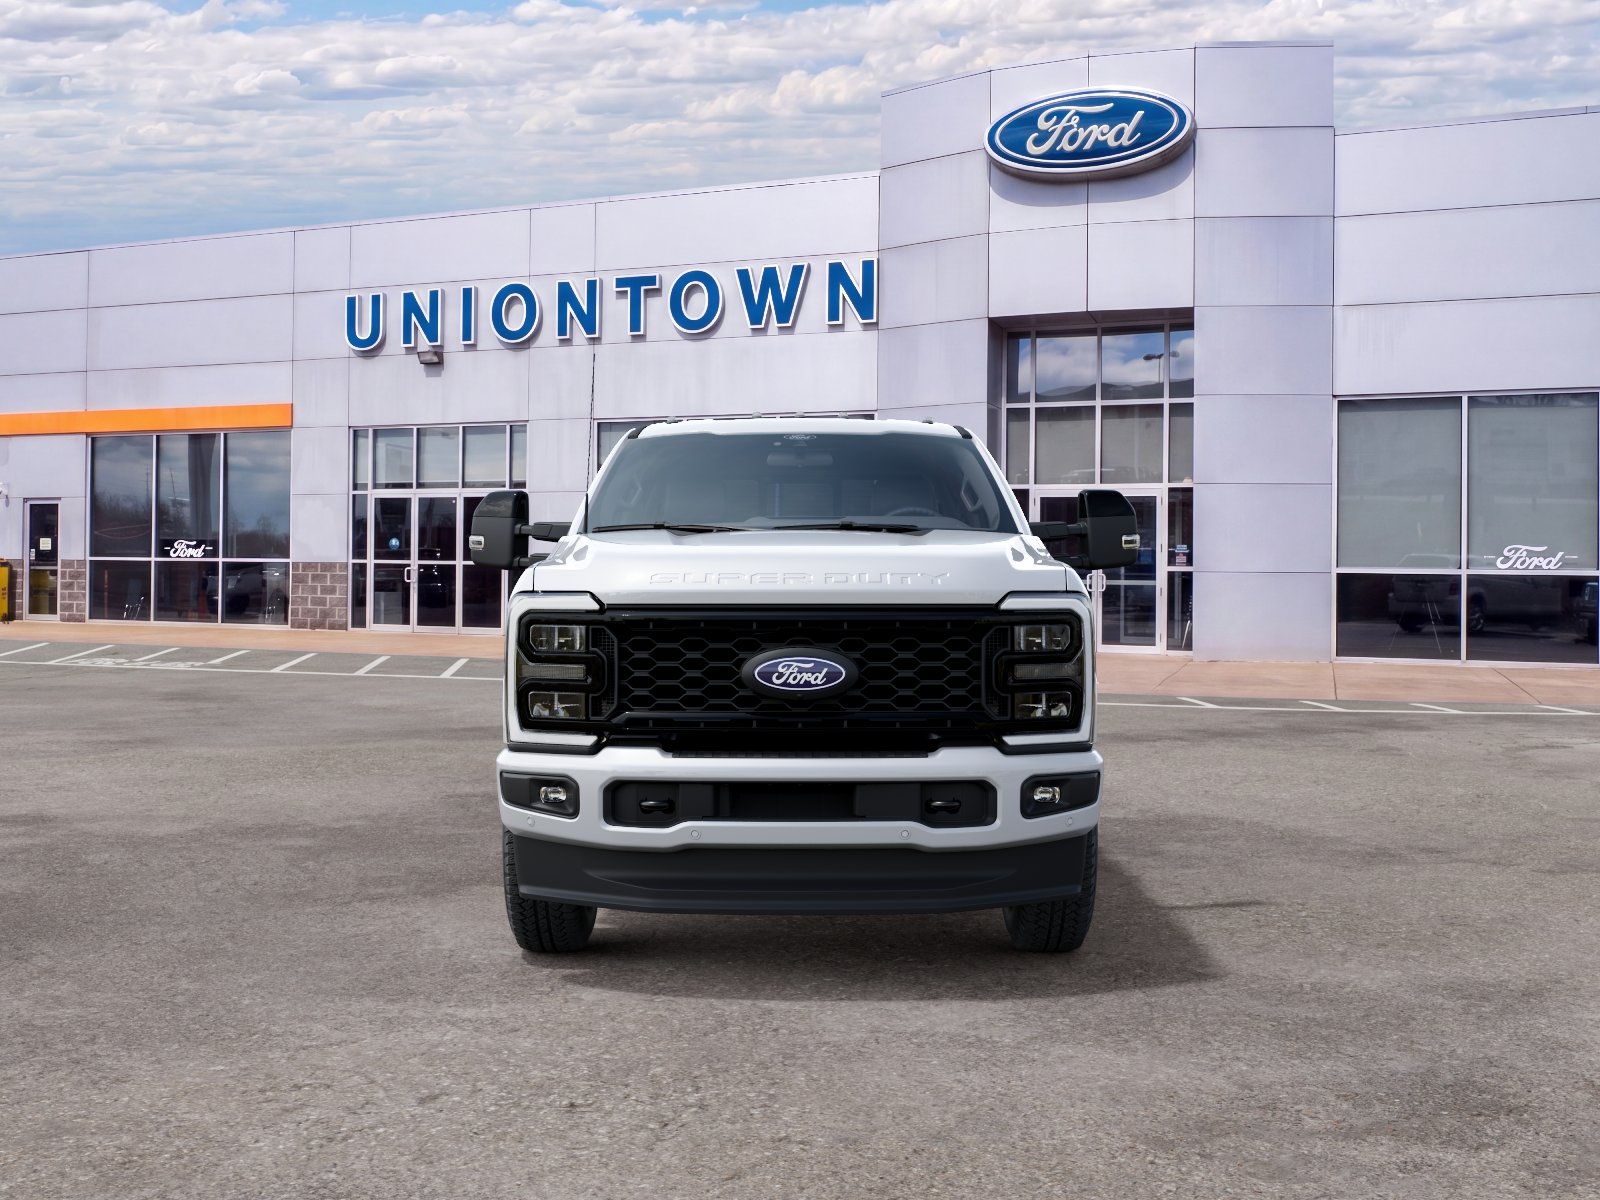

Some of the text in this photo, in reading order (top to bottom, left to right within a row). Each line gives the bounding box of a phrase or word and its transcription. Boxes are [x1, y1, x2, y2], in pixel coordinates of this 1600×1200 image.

[1026, 102, 1145, 155] Ford
[345, 258, 878, 351] UNIONTOWN
[170, 540, 205, 558] Ford
[1496, 544, 1564, 569] Ford
[649, 572, 950, 585] SUPER DUTY
[771, 661, 828, 684] Ford
